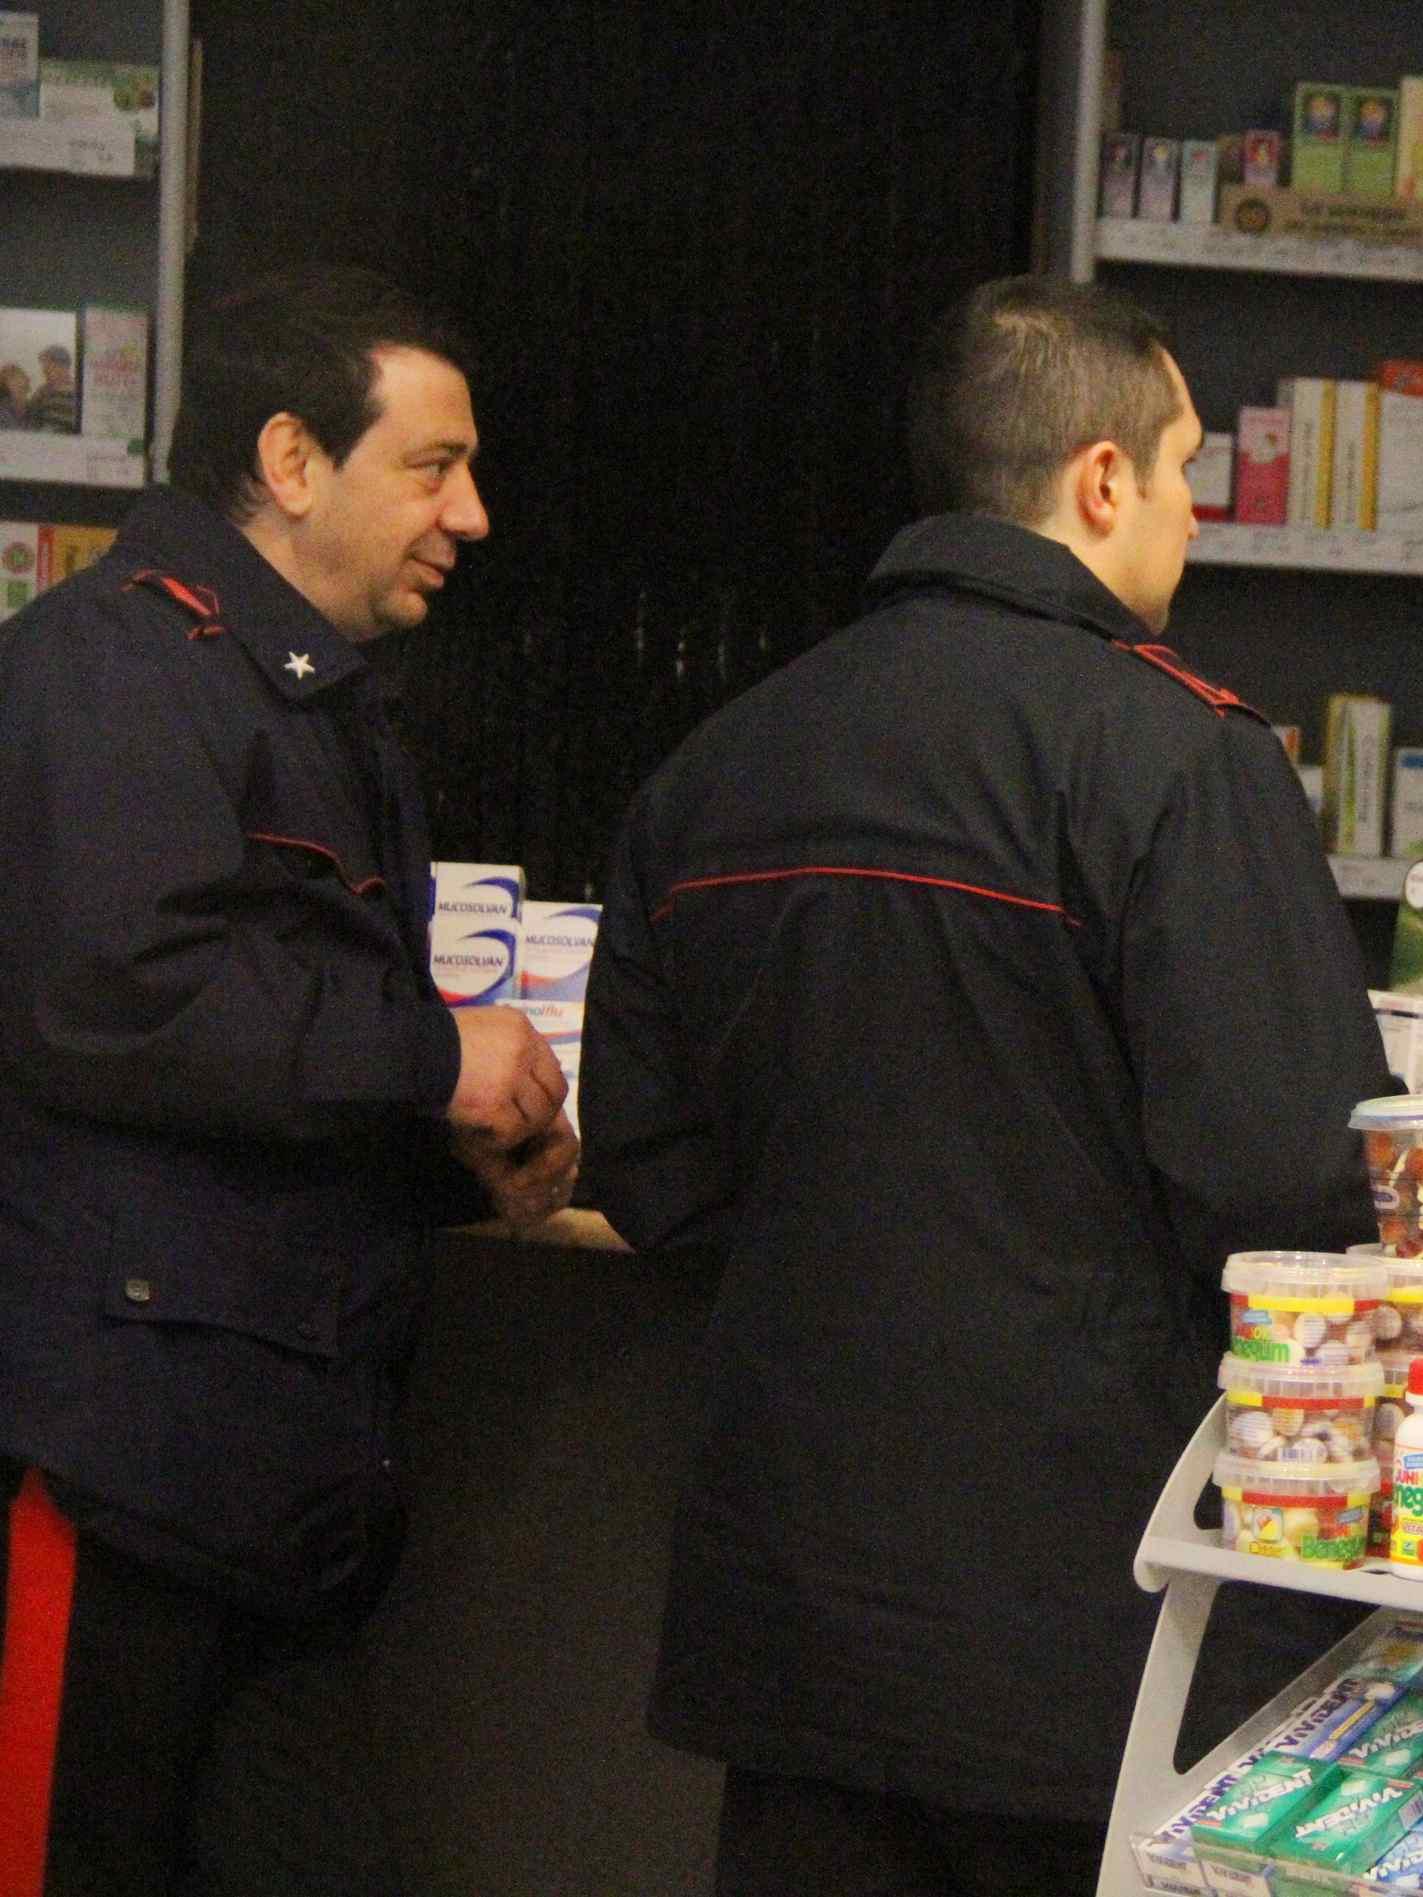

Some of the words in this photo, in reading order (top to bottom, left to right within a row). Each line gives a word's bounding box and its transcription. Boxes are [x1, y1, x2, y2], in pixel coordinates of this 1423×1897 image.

[438, 902, 508, 915] MUCOSOLVAN
[525, 935, 594, 947] MUCOSOLVAN
[434, 955, 504, 968] MUCOSOLVAN
